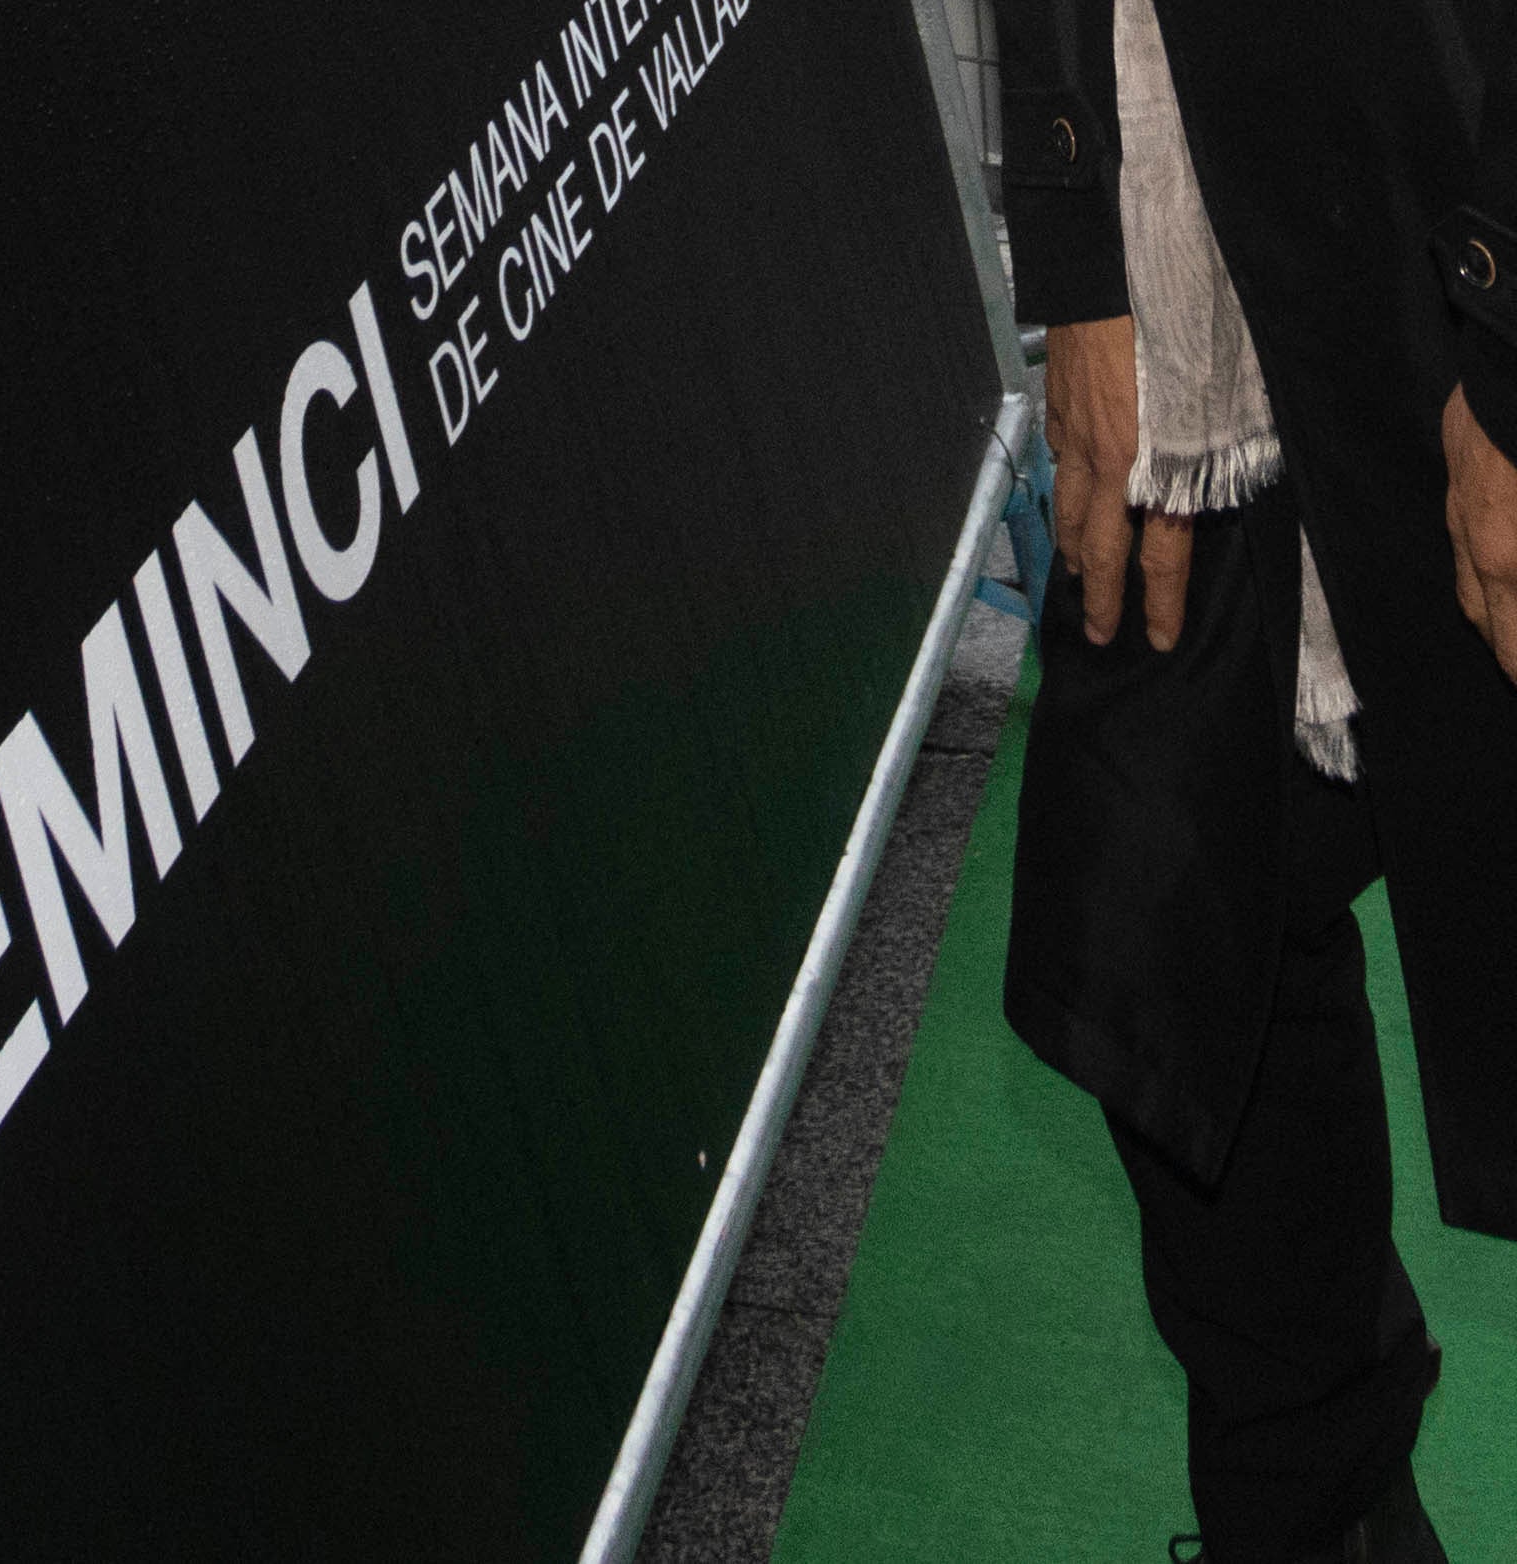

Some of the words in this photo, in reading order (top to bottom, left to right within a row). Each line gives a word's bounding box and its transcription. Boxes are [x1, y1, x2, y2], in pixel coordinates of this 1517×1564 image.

[399, 59, 569, 321] SEMANA
[427, 295, 499, 447] DE
[497, 161, 593, 342] CINE
[587, 87, 646, 213] DE
